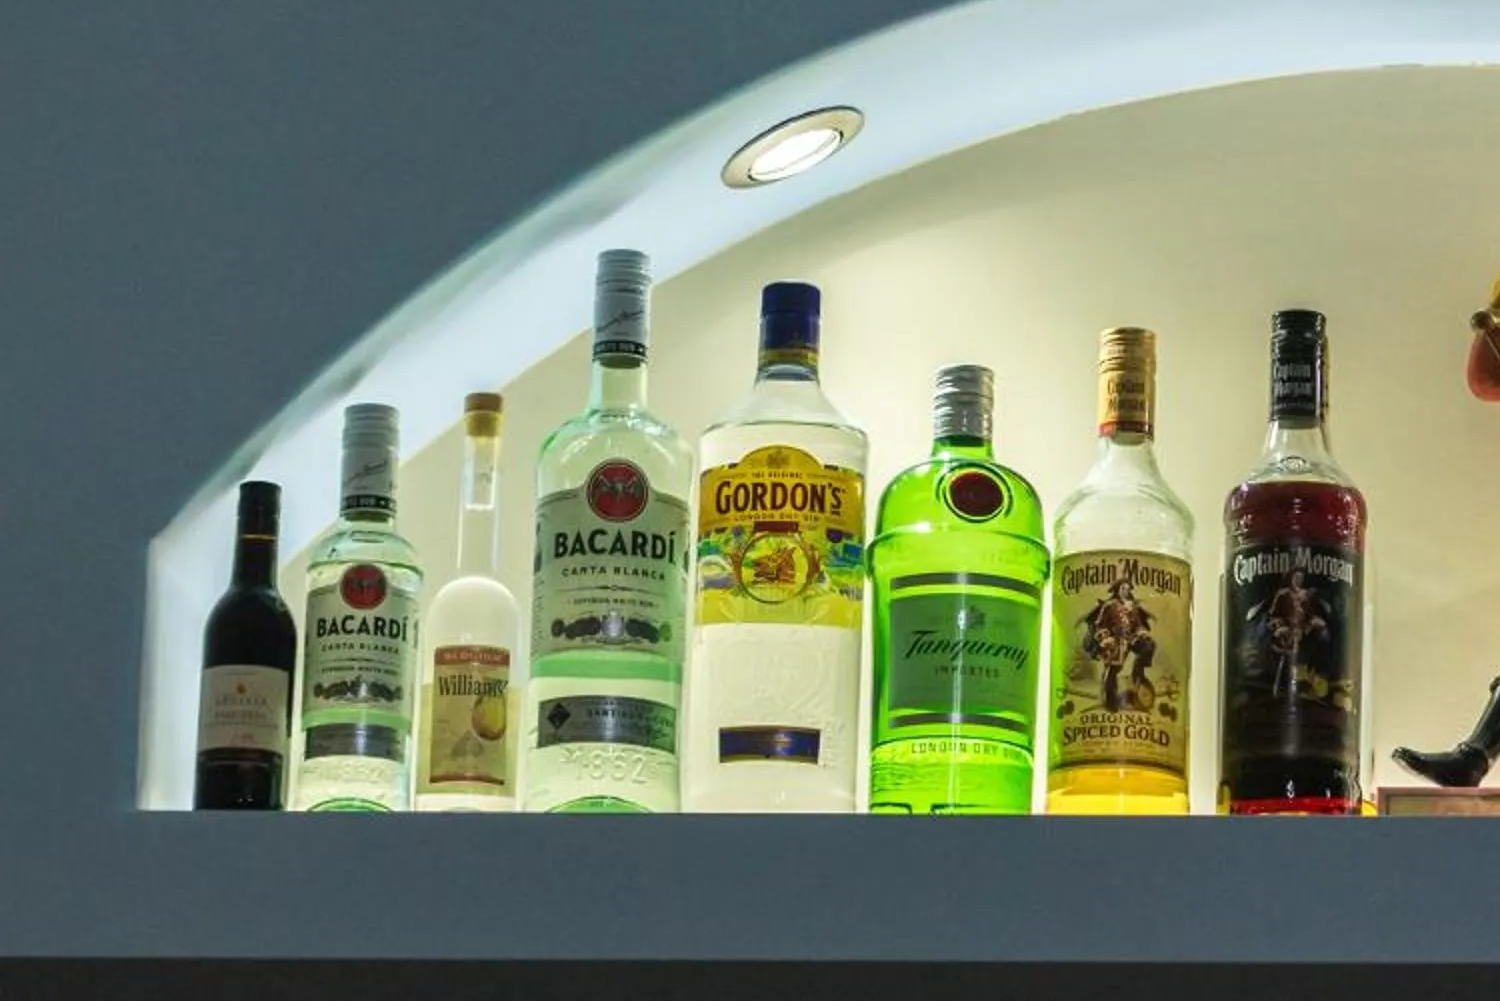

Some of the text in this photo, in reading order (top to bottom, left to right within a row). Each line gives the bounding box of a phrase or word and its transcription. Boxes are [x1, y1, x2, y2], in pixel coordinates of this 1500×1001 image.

[715, 480, 843, 515] GORDON'S
[1061, 558, 1182, 597] Captain Morgan
[1233, 545, 1354, 590] Captain Morgan
[904, 630, 1029, 671] Tanqueray
[1062, 724, 1171, 748] SPICED GOLD
